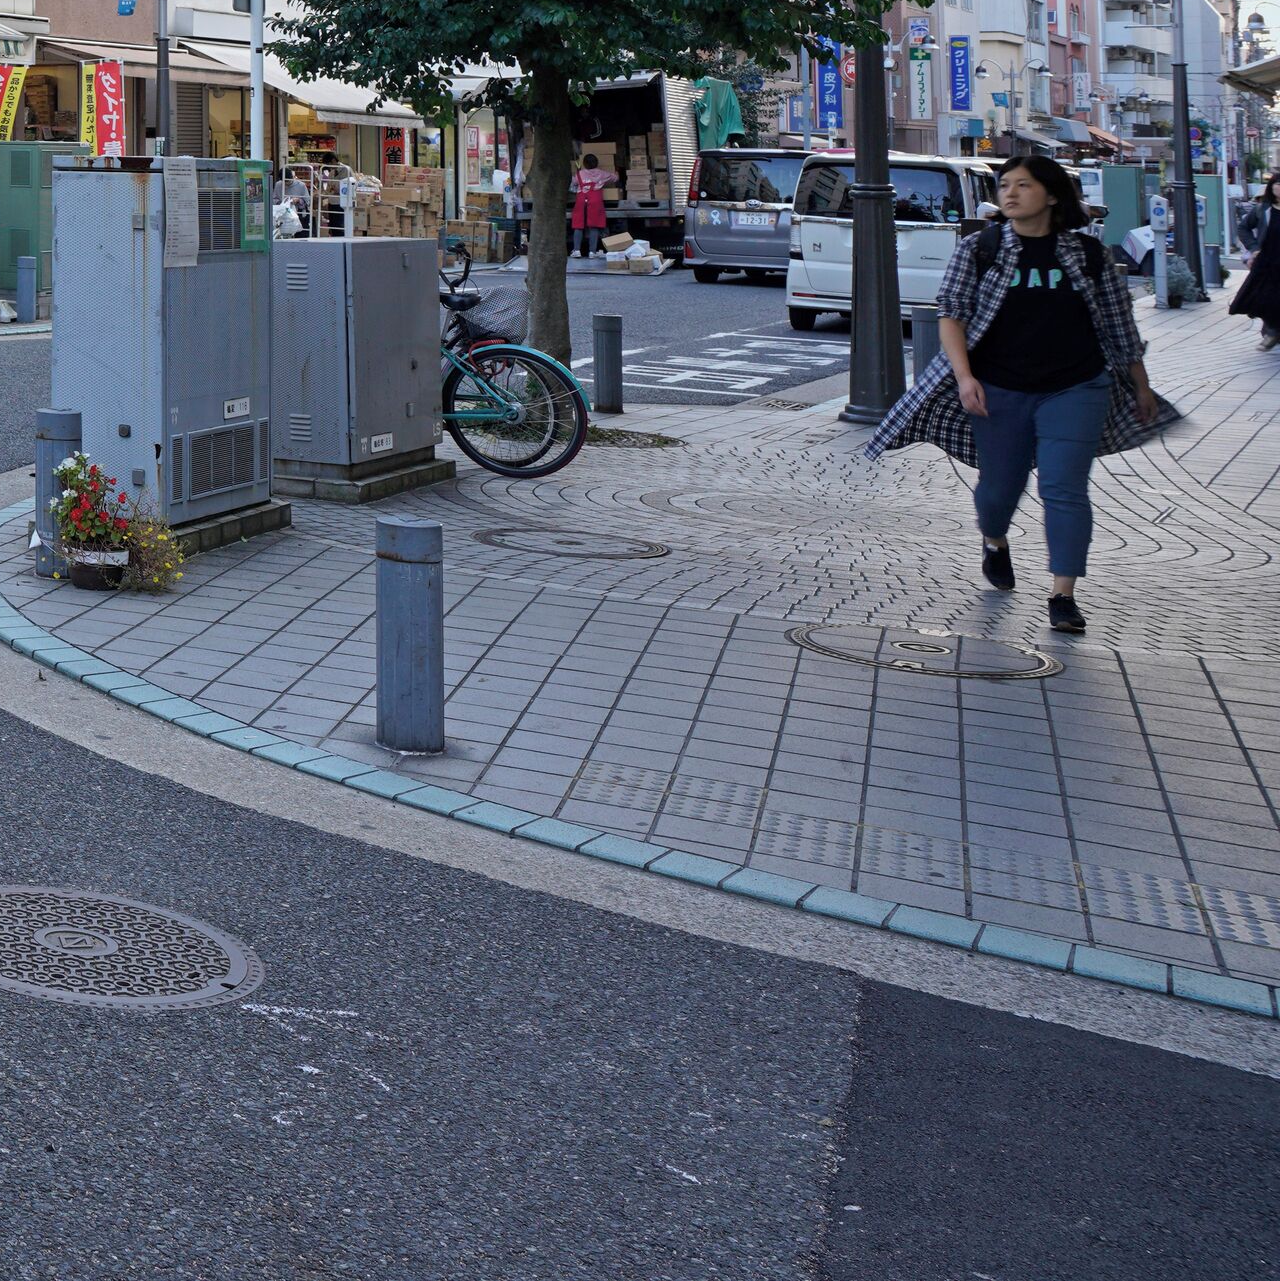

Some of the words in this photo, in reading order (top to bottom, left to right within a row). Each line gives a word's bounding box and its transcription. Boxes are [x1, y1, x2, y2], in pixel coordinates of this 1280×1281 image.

[953, 49, 969, 100] クリーニング
